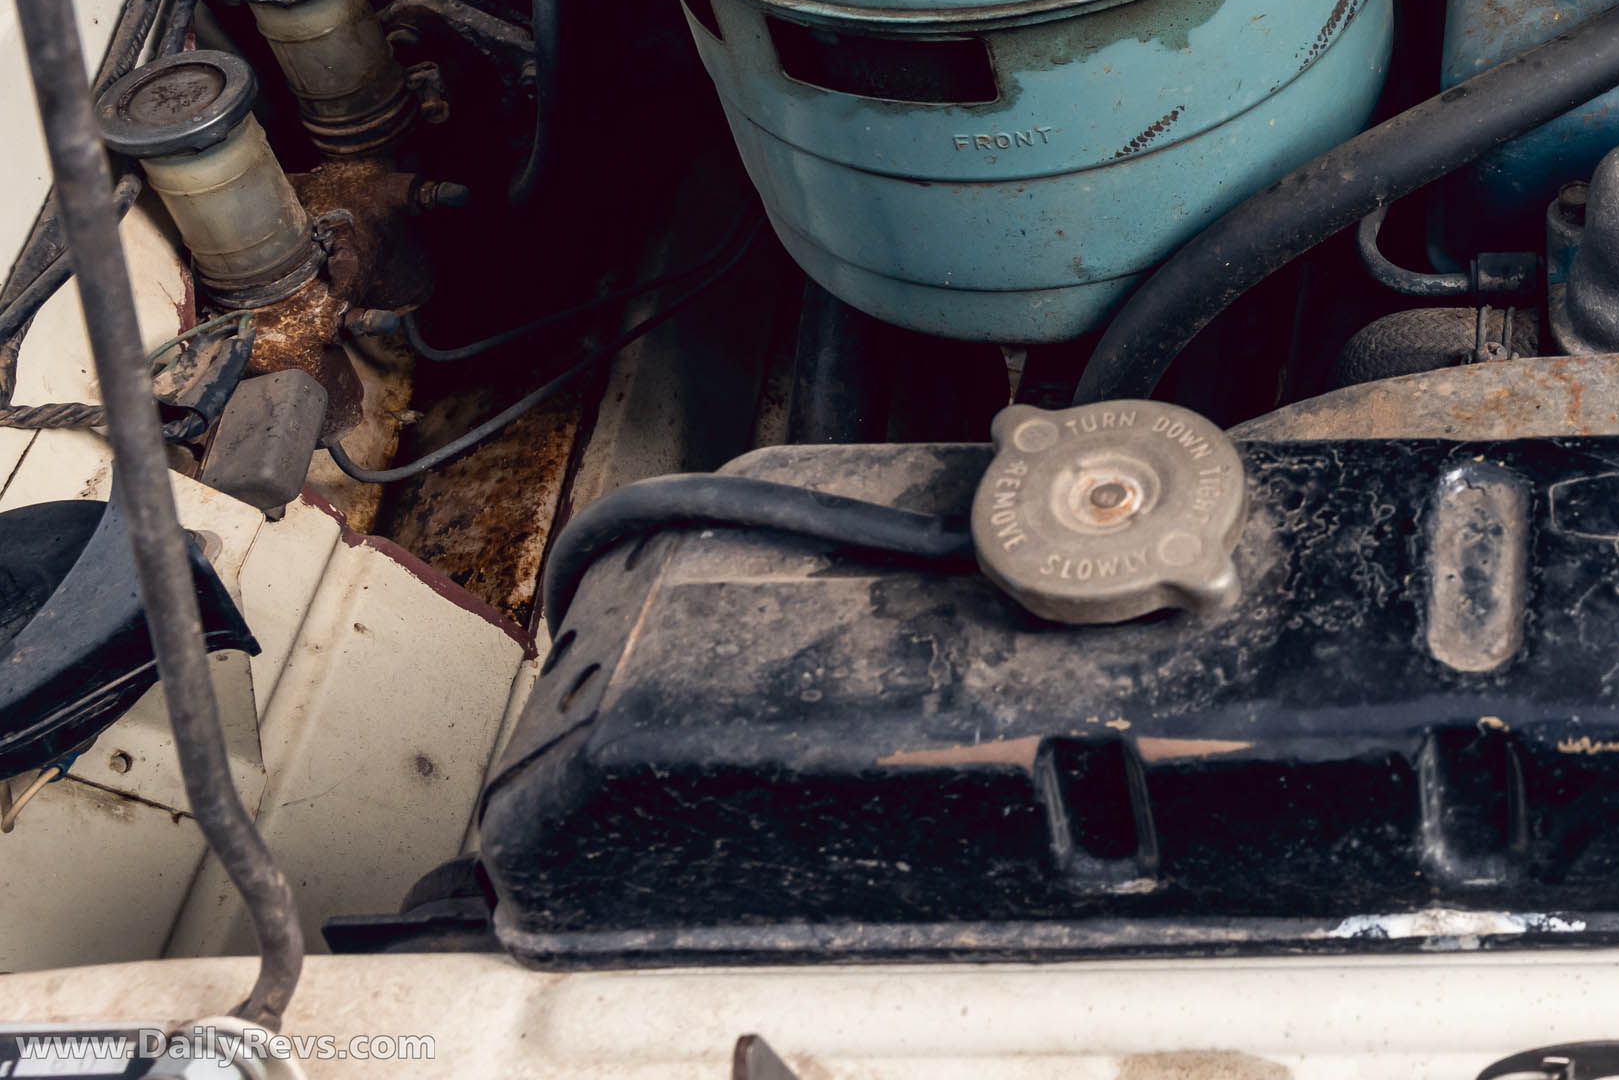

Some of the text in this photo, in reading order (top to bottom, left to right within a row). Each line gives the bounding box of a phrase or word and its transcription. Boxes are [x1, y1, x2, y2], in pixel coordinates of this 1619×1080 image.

[952, 126, 1053, 152] FRONT
[1065, 411, 1137, 435] TURN
[1152, 416, 1213, 461] DOWN
[991, 460, 1149, 580] REMOVE SLOWLY
